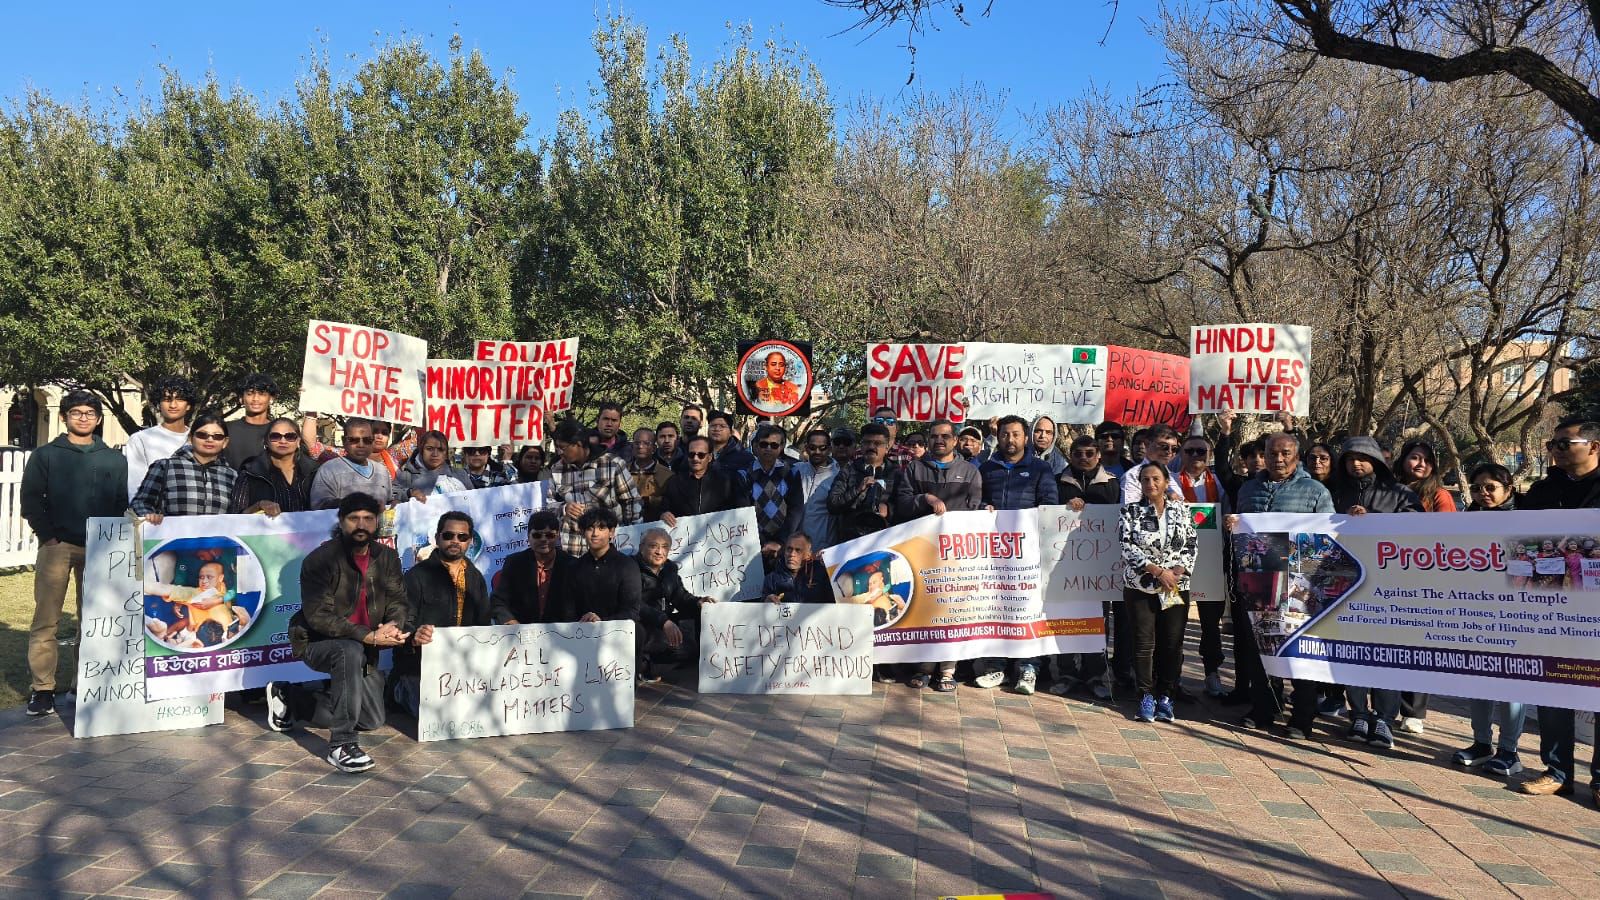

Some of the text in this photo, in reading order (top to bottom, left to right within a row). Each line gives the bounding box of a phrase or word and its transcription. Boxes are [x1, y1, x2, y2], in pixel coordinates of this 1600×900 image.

[313, 324, 389, 361] STOP
[1196, 328, 1275, 354] HINDU
[330, 358, 402, 394] HATE
[870, 344, 966, 382] SAVE
[972, 364, 1104, 388] HINDUS HAVE
[1228, 358, 1304, 388] LIVES
[427, 365, 544, 400] MINORITIES
[341, 388, 414, 422] CRIME
[870, 384, 966, 422] HINDUS
[972, 386, 1097, 407] RIGHT TO LIVE
[1198, 384, 1294, 412] MATTER
[428, 404, 543, 441] MATTER
[98, 522, 128, 542] WE
[614, 522, 749, 555] BGLADESH
[938, 532, 1025, 560] PROTEST
[1052, 538, 1112, 562] STOP
[1376, 540, 1508, 572] Protest
[684, 564, 746, 595] TTACKS
[926, 582, 1036, 594] Shri Chinmoy Krishna Das
[124, 590, 144, 612] &
[1374, 586, 1568, 606] Against The Attacks on Temple
[1337, 614, 1354, 624] and
[1356, 614, 1388, 626] Forced
[1390, 617, 1434, 628] Dismissal
[1436, 619, 1460, 629] from
[1462, 621, 1483, 630] Jobs
[1485, 622, 1497, 631] of
[1499, 622, 1536, 634] Hindus
[1538, 625, 1558, 634] and
[1348, 602, 1387, 614] Killings,
[1390, 604, 1444, 616] Destruction
[1446, 606, 1456, 616] of
[1458, 607, 1496, 620] Houses,
[1499, 610, 1540, 622] Looting
[1542, 611, 1555, 622] of
[710, 624, 854, 651] WE DEMAND
[902, 630, 928, 641] CENTER
[930, 629, 947, 640] FOR
[948, 626, 995, 639] BANGLADESH
[996, 626, 1026, 637] (HRCB)
[1424, 631, 1518, 648] Across the Country
[153, 656, 212, 674] হিউমেন
[216, 650, 262, 668] রাইটস
[504, 647, 549, 668] ALL
[708, 653, 872, 680] SAFETY FOR HINDUS
[1298, 640, 1544, 676] HUMAN RIGHTS CENTER FOR BANGLADESH (HRCB)
[439, 667, 562, 698] BANGLADESHI
[504, 694, 585, 724] MATTERS
